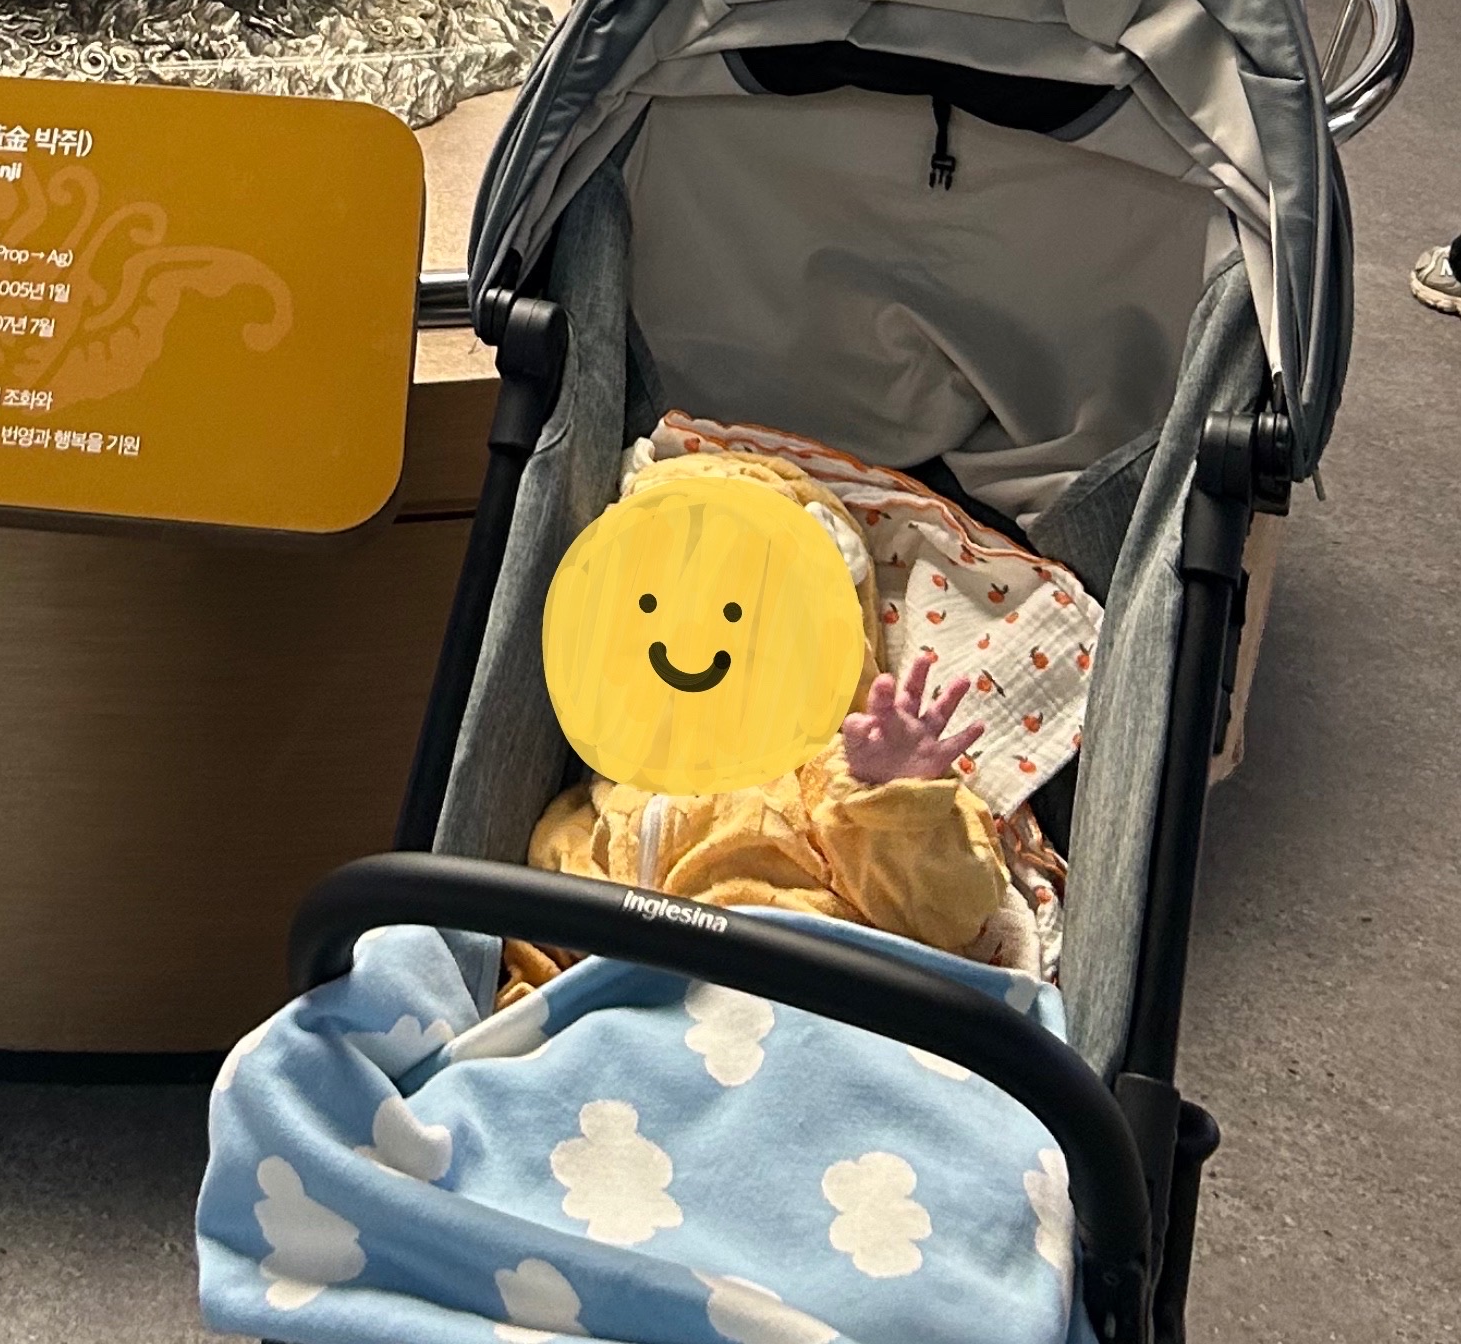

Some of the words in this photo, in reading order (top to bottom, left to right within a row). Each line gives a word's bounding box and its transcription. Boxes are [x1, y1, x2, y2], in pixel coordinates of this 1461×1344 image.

[35, 128, 92, 157] 박쥐)
[47, 250, 72, 267] Ag)
[50, 284, 69, 302] 1월
[31, 319, 54, 337] 7월
[3, 390, 52, 410] 조화와
[2, 427, 51, 448] 번영과
[55, 431, 103, 452] 행복을
[107, 436, 139, 455] 기원
